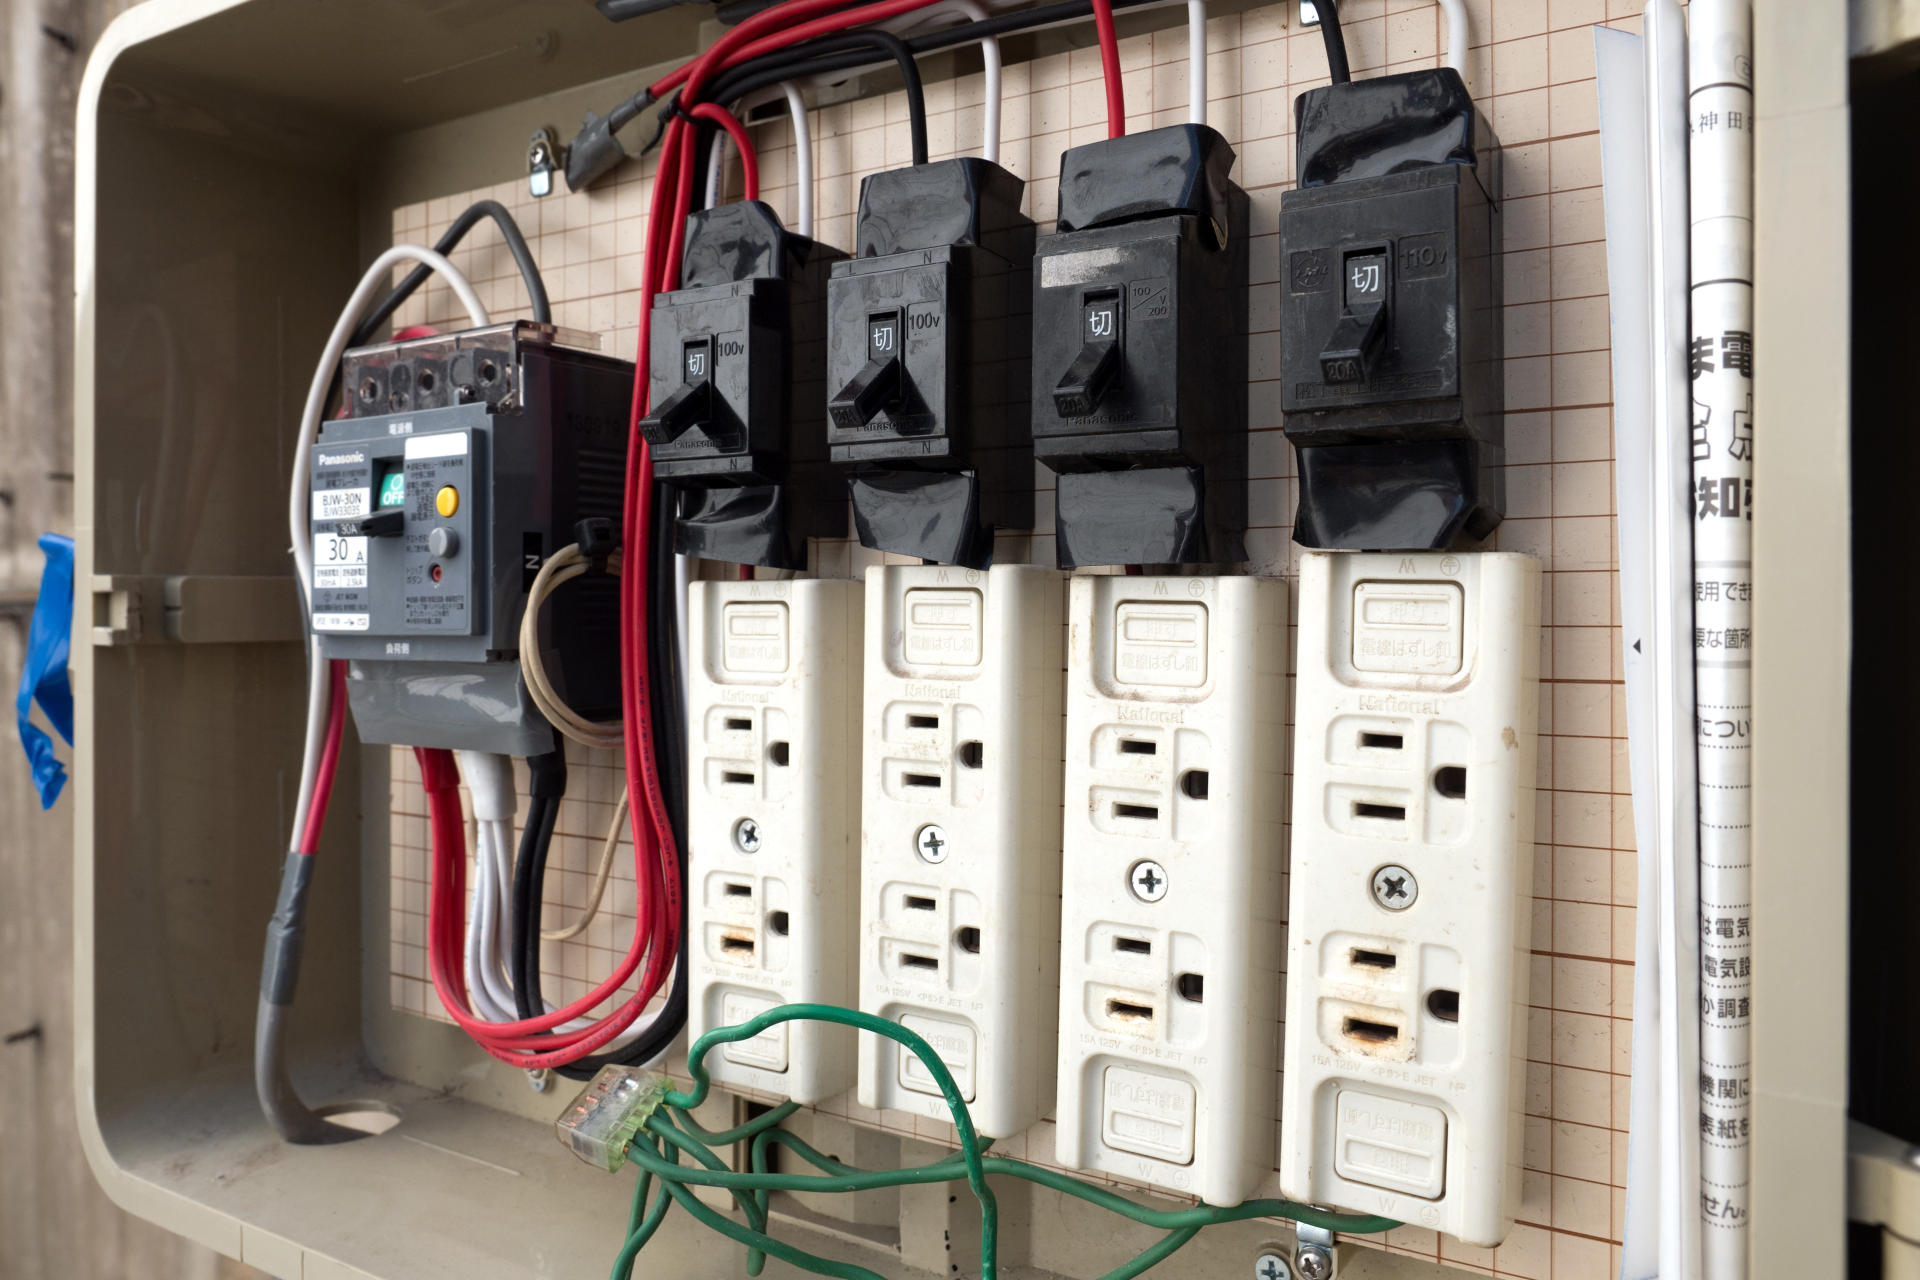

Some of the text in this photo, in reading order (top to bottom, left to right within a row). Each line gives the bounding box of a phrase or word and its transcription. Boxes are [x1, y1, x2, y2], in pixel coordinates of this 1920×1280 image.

[923, 252, 932, 264] N
[1352, 264, 1379, 293] 切
[1132, 286, 1152, 297] 100
[1089, 310, 1111, 337] 切
[873, 327, 892, 351] 切
[688, 353, 705, 375] 切
[1326, 360, 1359, 380] 20A
[922, 442, 931, 455] N
[317, 449, 366, 467] Panasonic
[730, 458, 738, 470] N
[322, 492, 362, 507] BJW-30N
[382, 490, 405, 506] OFF
[340, 523, 358, 535] 30A
[328, 538, 364, 562] 30 A
[1165, 1048, 1184, 1062] JET
[1413, 1071, 1437, 1087] JET
